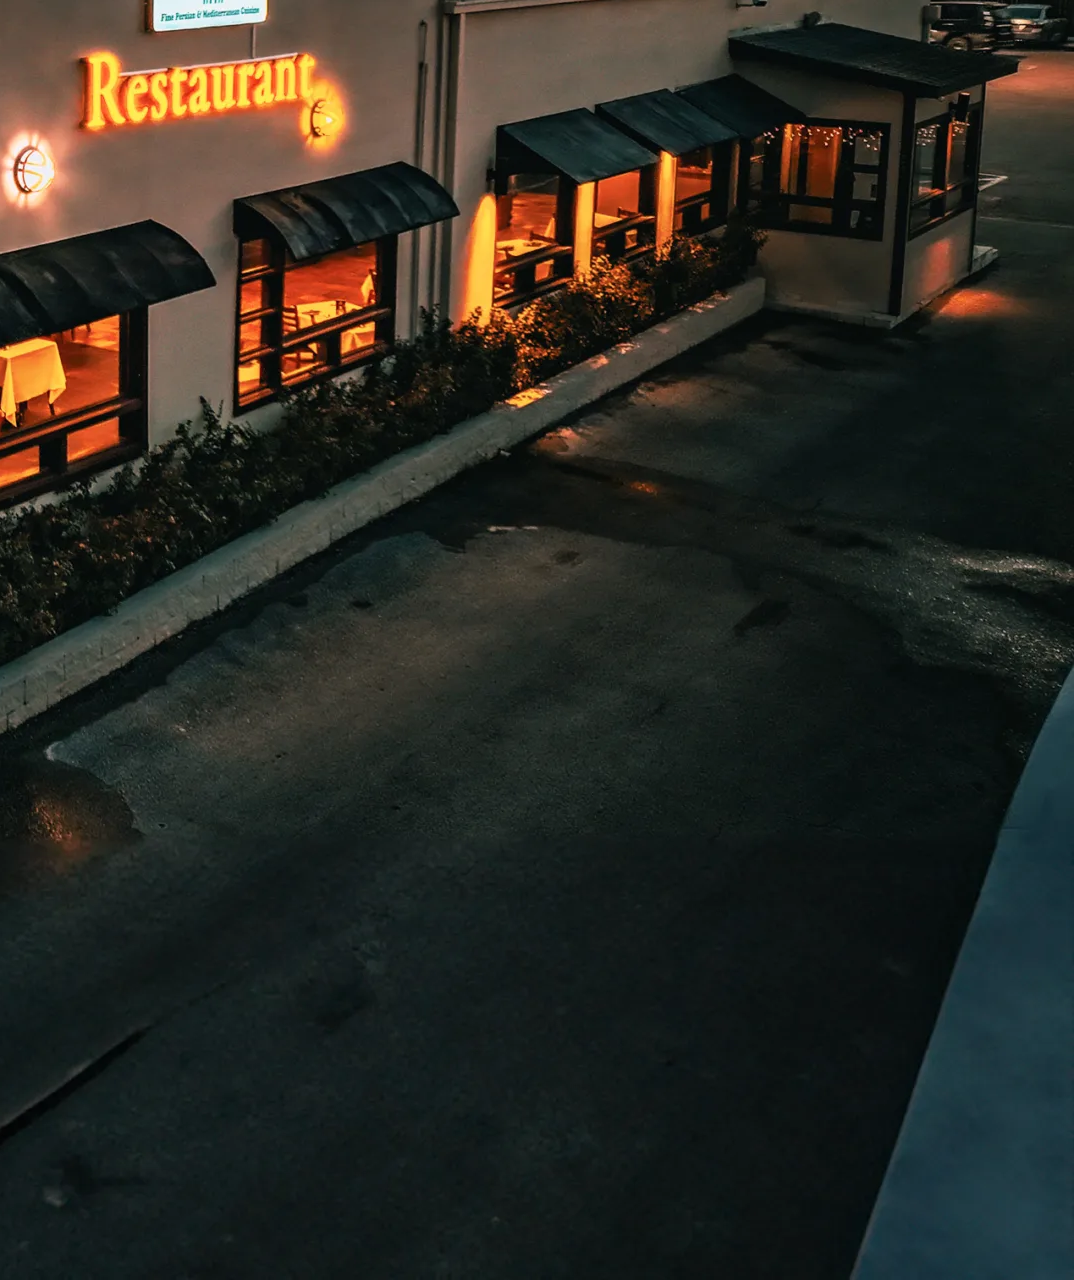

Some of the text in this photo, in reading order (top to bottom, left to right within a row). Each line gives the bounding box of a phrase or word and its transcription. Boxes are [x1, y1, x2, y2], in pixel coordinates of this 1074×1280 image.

[160, 6, 260, 22] Fine Persian & Mediterranean Cuisine
[86, 52, 316, 129] Restaurant
